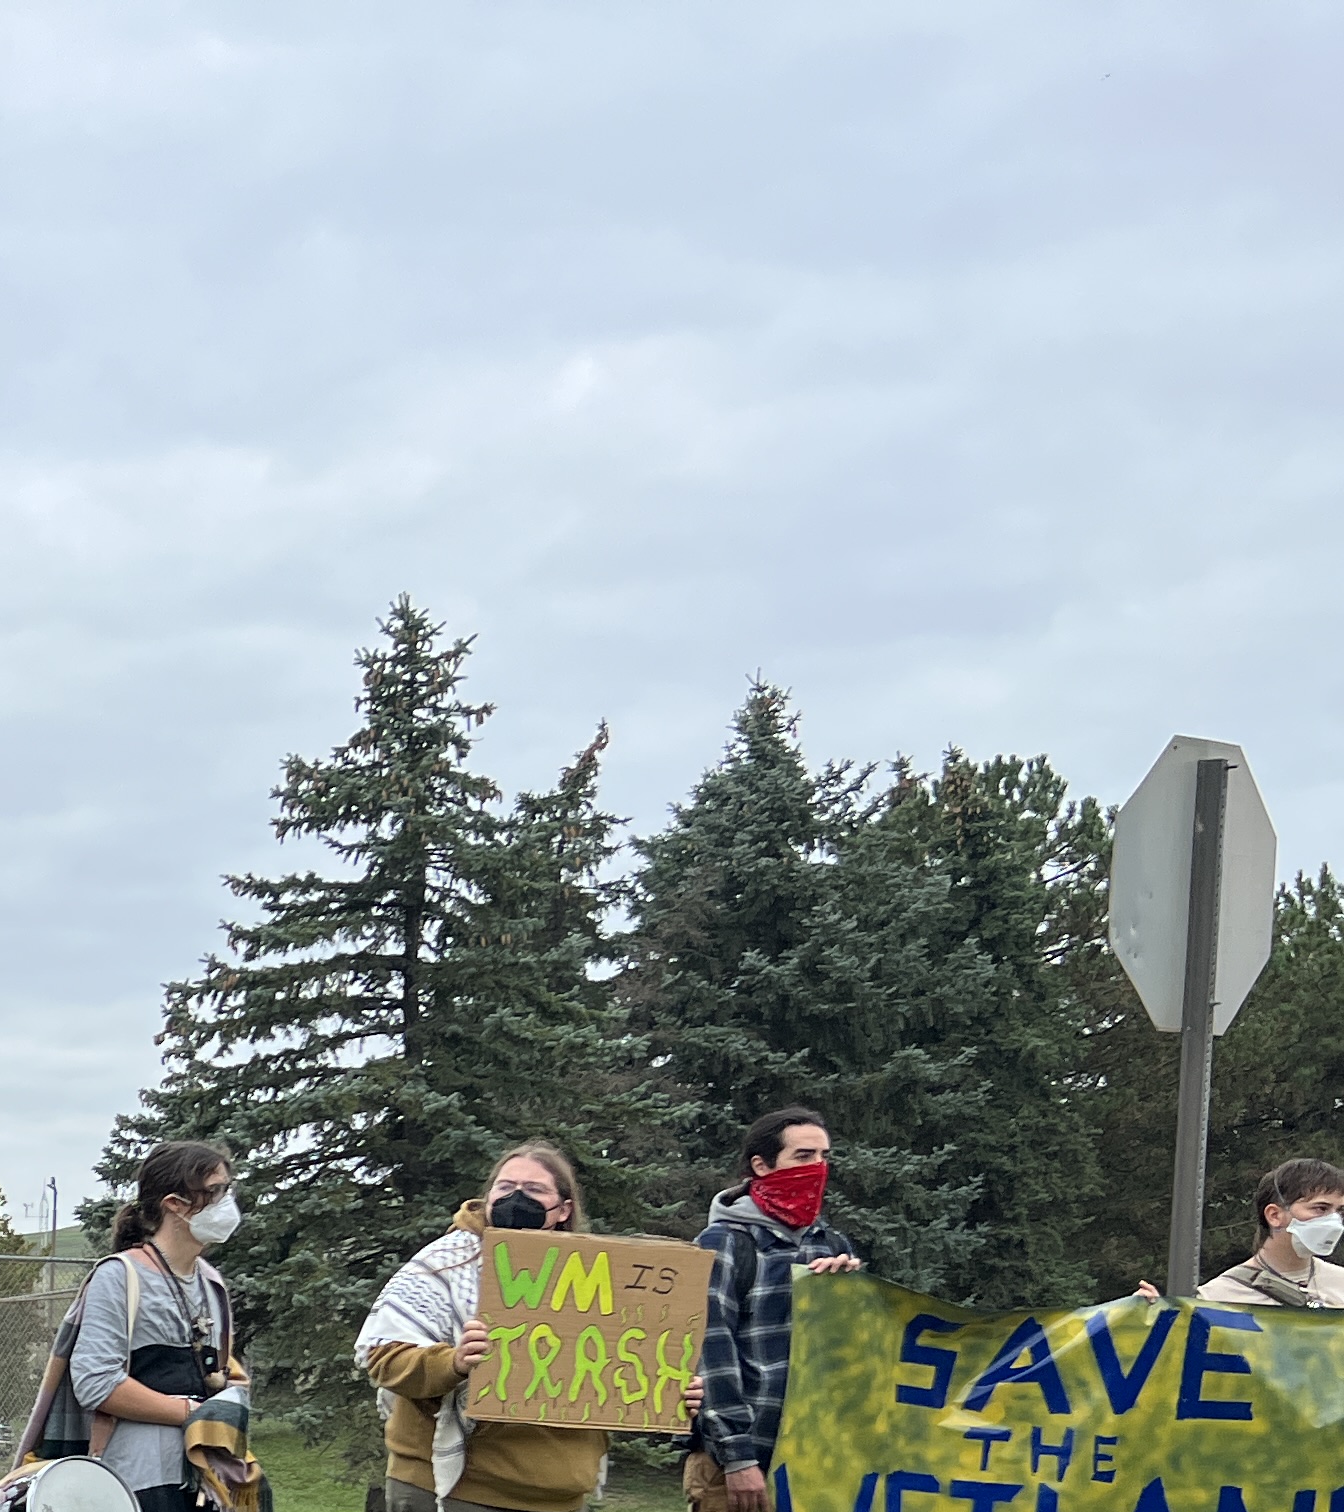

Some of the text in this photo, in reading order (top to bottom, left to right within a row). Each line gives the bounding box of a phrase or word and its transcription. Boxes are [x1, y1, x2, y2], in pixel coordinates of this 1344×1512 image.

[493, 1241, 679, 1316] WM IS
[486, 1322, 695, 1422] TRASH
[894, 1306, 1263, 1421] SAVE
[962, 1426, 1119, 1483] THE
